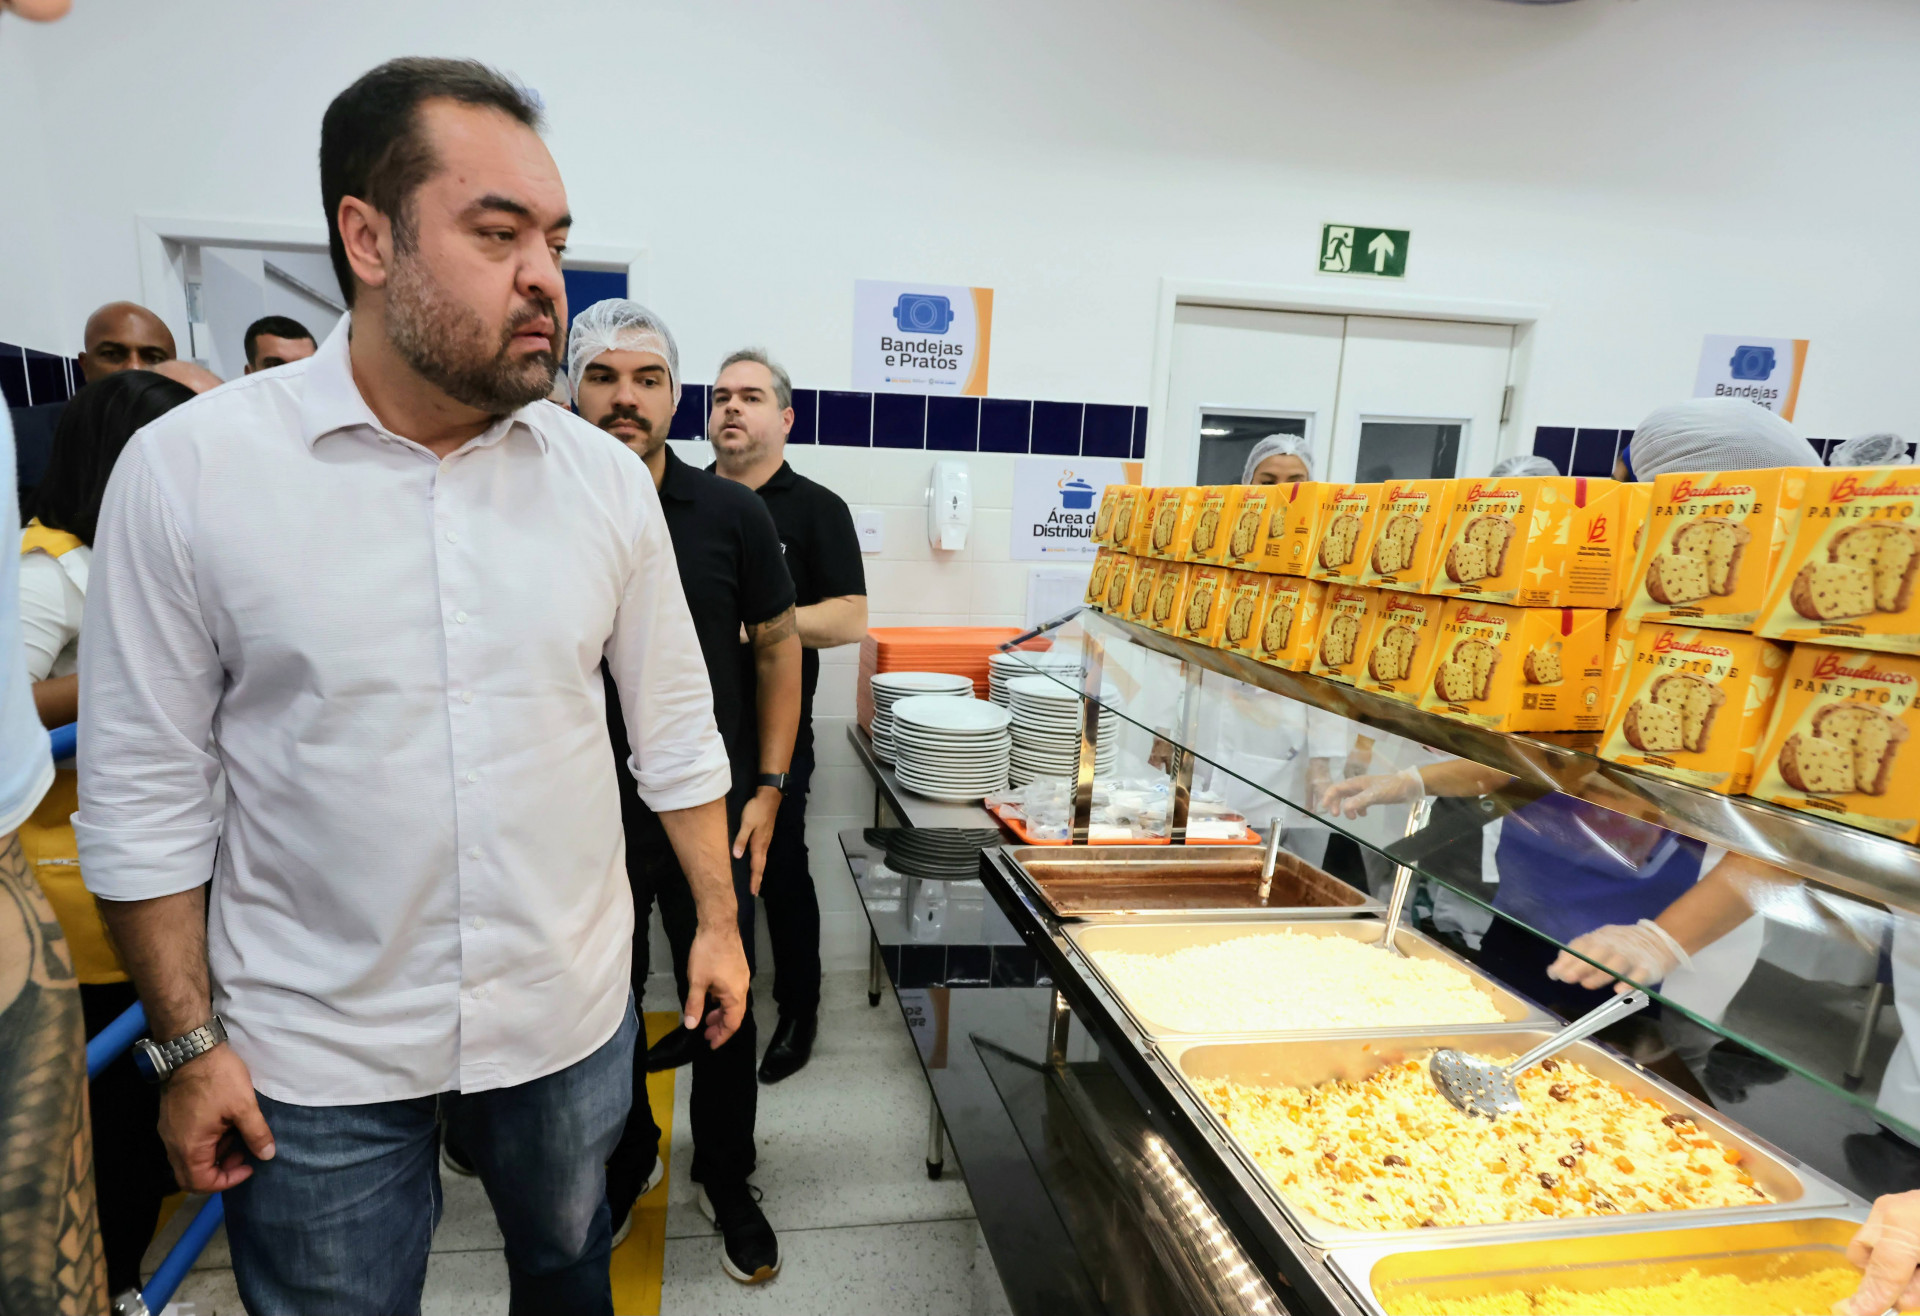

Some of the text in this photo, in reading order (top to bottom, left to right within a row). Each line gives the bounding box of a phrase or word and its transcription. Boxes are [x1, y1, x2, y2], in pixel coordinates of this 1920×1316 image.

[881, 337, 963, 357] Bandejas
[885, 353, 957, 370] e Pratos
[1715, 383, 1778, 400] Bandejas
[1670, 479, 1752, 503] Bauducco
[1047, 507, 1096, 524] Área d
[1326, 504, 1370, 512] PANETTONE
[1381, 504, 1432, 512] PANETTONE
[1456, 504, 1526, 513] PANETTONE
[1655, 503, 1763, 516] PANETTONE
[1808, 506, 1920, 518] PANETTO
[1033, 524, 1093, 538] Distribui
[1378, 611, 1429, 627] PANETTONE
[1444, 623, 1512, 641] PANETTONE
[1653, 629, 1730, 657] Bauducco
[1637, 652, 1739, 678] PANETTONE
[1813, 652, 1913, 684] Bauducco
[1794, 679, 1920, 709] PANETTONE
